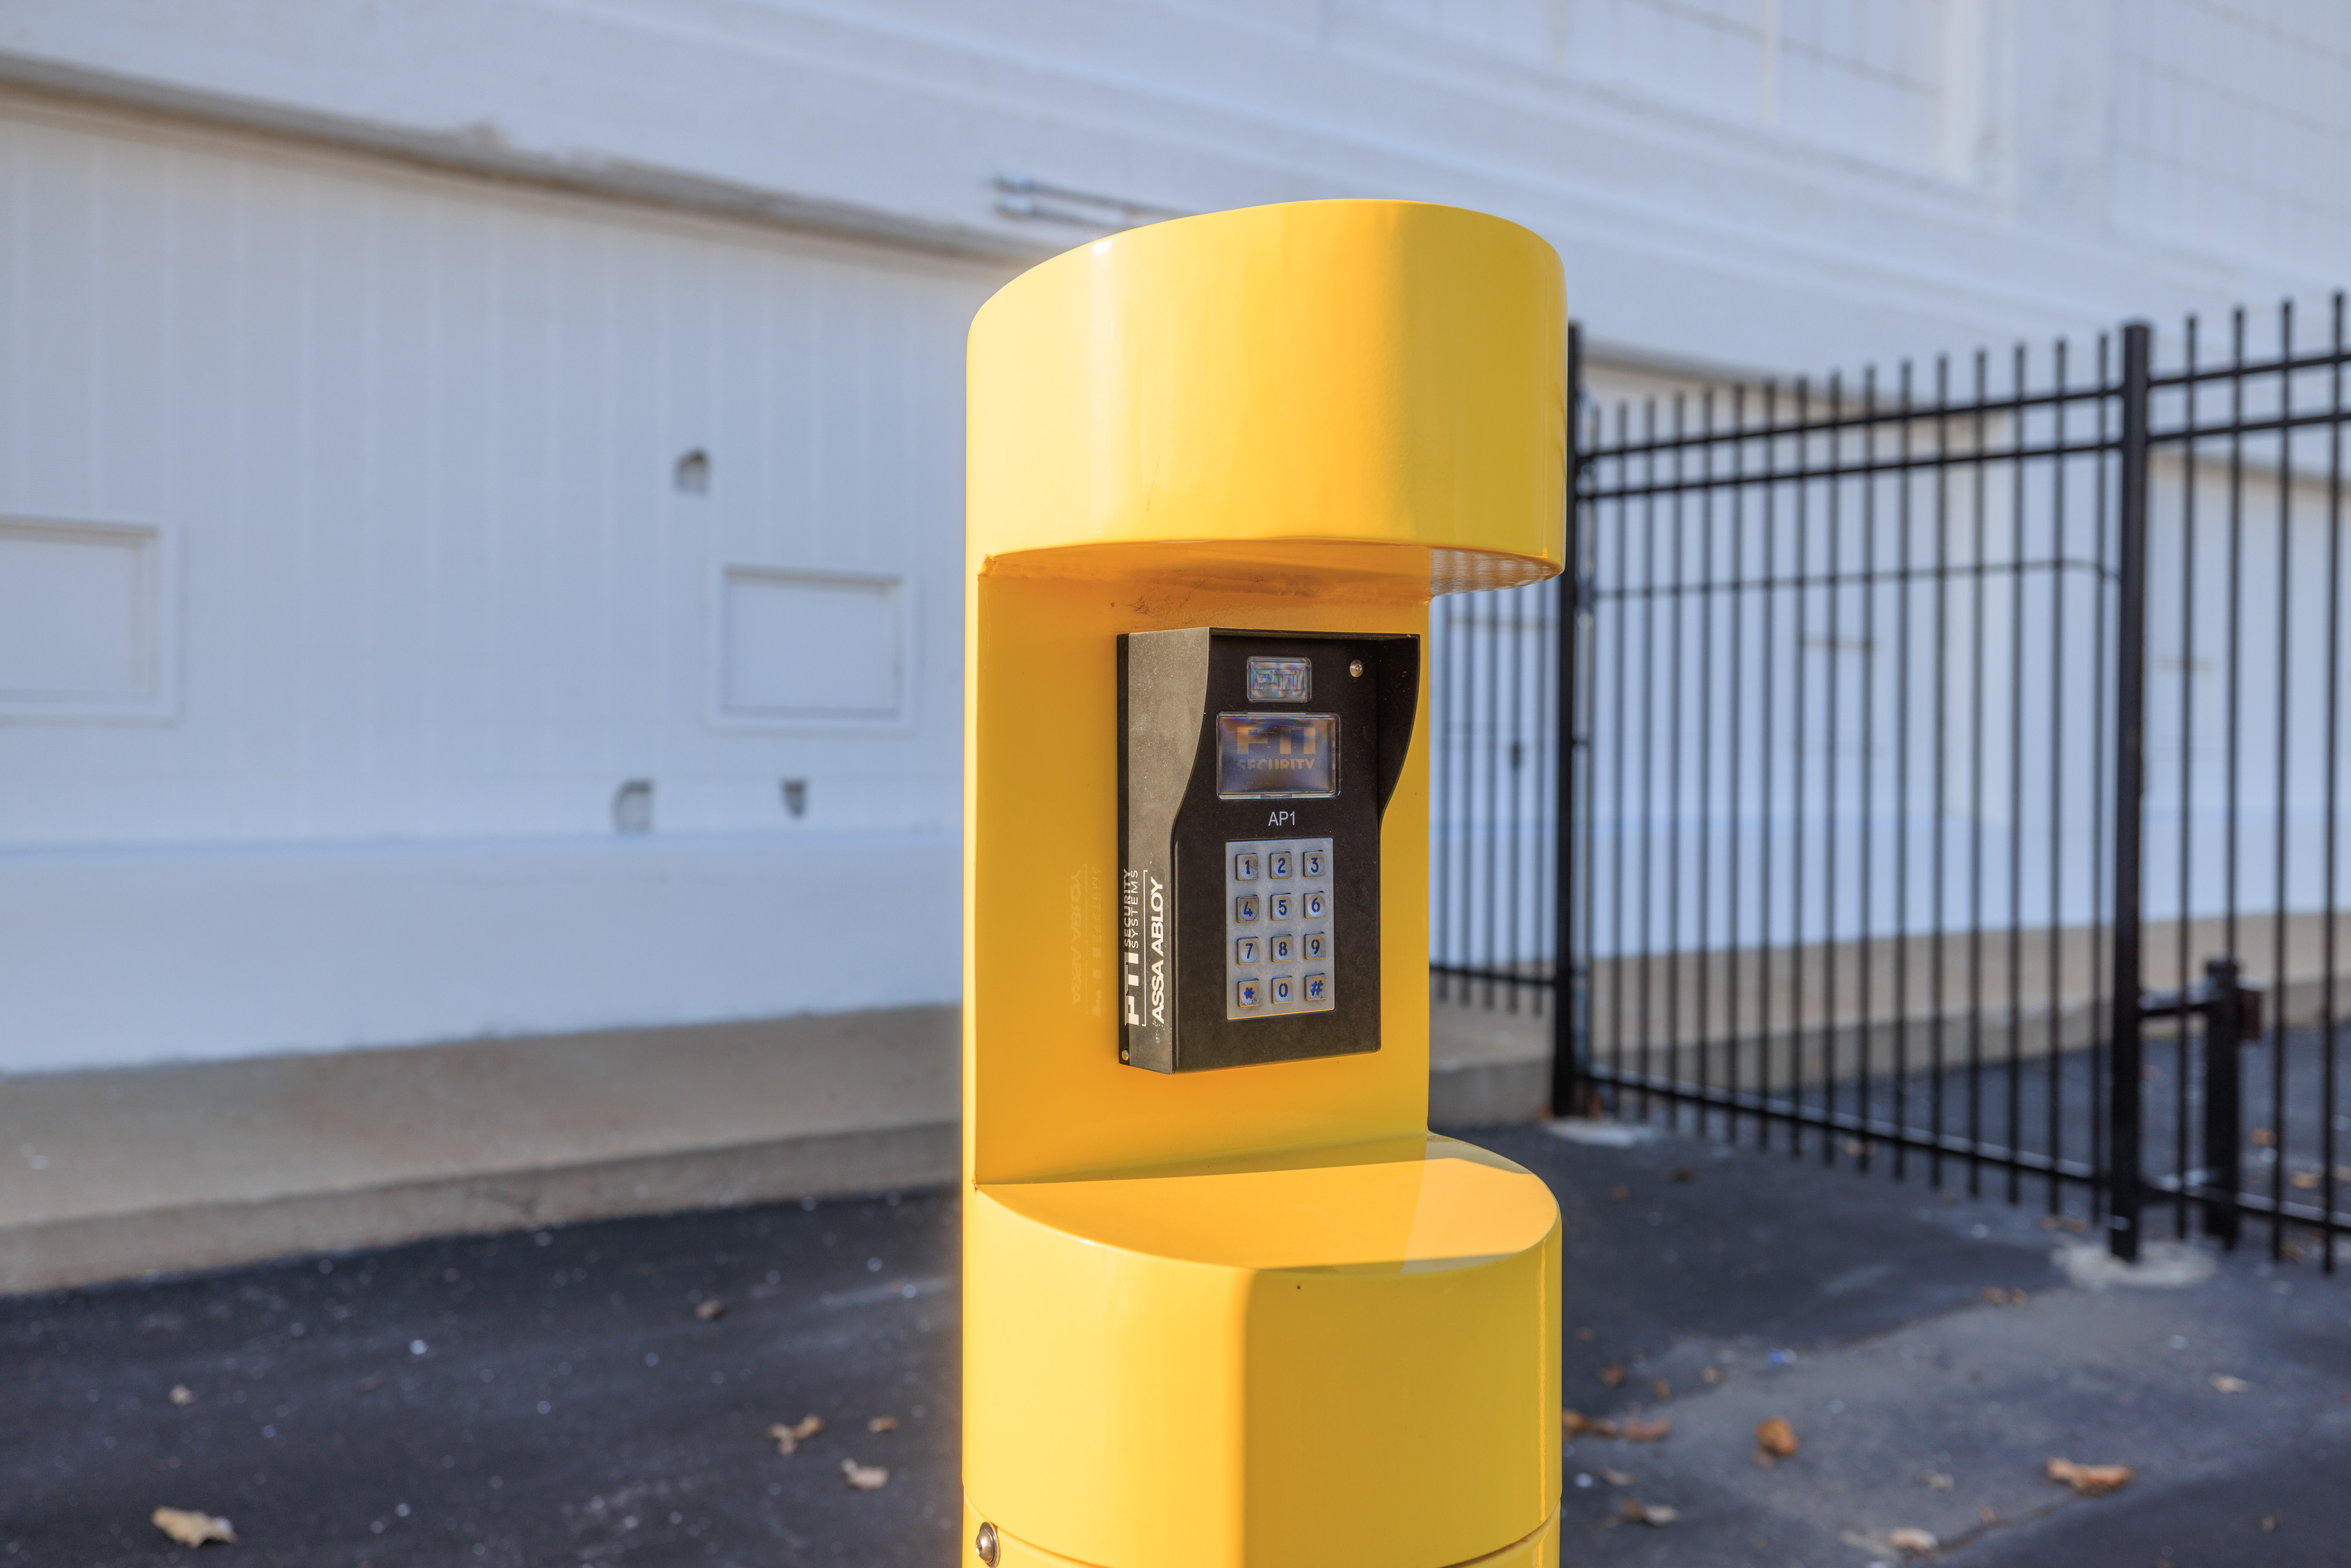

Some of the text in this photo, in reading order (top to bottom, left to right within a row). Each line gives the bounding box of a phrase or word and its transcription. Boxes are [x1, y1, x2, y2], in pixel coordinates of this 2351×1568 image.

[1252, 668, 1304, 691] PTI
[1237, 758, 1315, 769] SECURITY
[1268, 810, 1295, 826] AP1
[1245, 857, 1319, 875] 1 2 3
[1123, 868, 1131, 947] SECURITY
[1244, 897, 1320, 917] 4 5 6
[1151, 876, 1164, 1024] ASSA ABLOY
[1245, 939, 1320, 959] 7 8 9
[1124, 951, 1139, 1026] PTI
[1278, 983, 1288, 998] 0
